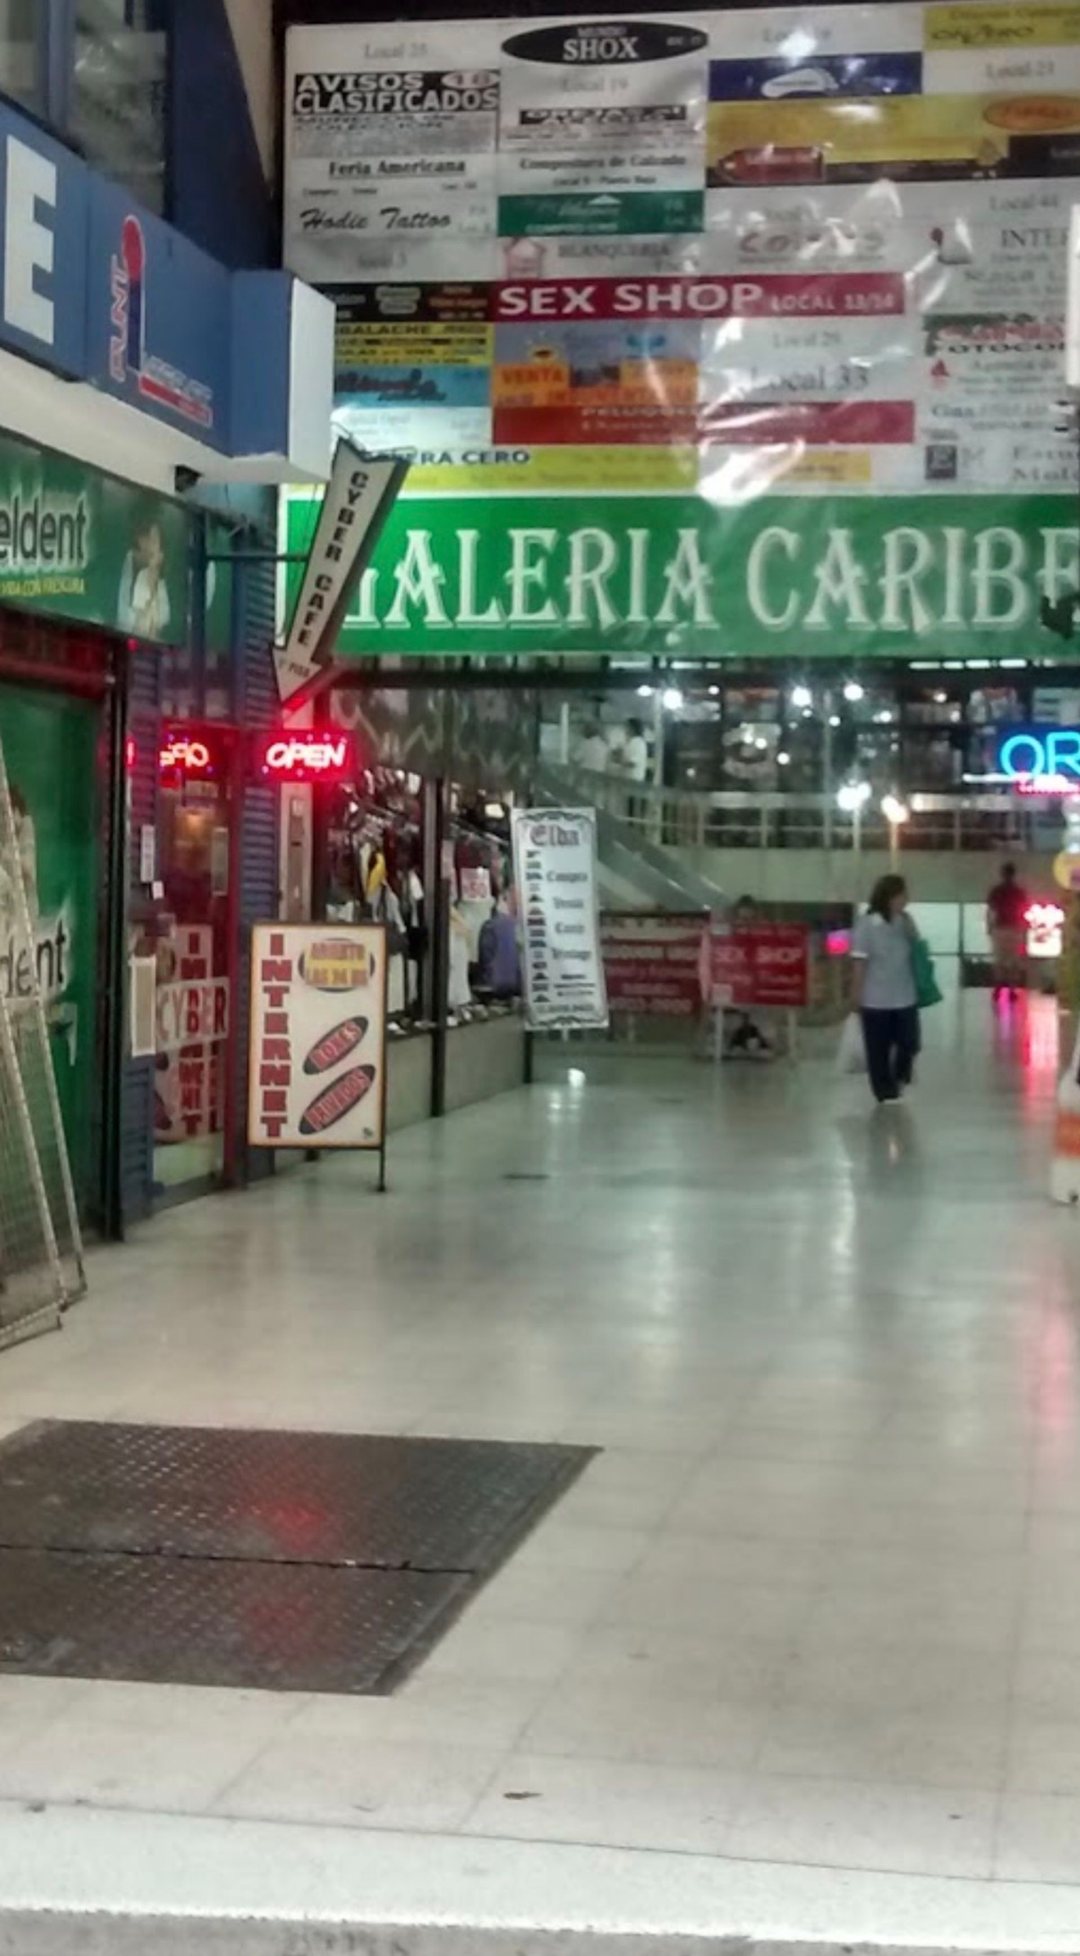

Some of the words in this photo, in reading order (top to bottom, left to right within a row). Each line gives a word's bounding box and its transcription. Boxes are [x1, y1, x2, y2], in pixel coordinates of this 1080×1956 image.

[563, 36, 639, 61] SHOX
[297, 73, 425, 92] AVISOS
[294, 89, 498, 114] CLASIFICADOS
[329, 161, 371, 176] Feria
[377, 158, 466, 174] Americana
[380, 206, 452, 231] Tattoo
[4, 133, 57, 345] E
[499, 285, 597, 316] SEX
[613, 281, 764, 314] SHOP
[769, 294, 836, 311] LOCAL
[461, 450, 530, 464] CERO
[296, 573, 334, 647] CAFE
[264, 741, 347, 769] OPEN
[155, 985, 227, 1043] CYBER
[259, 933, 293, 1138] INTERNET
